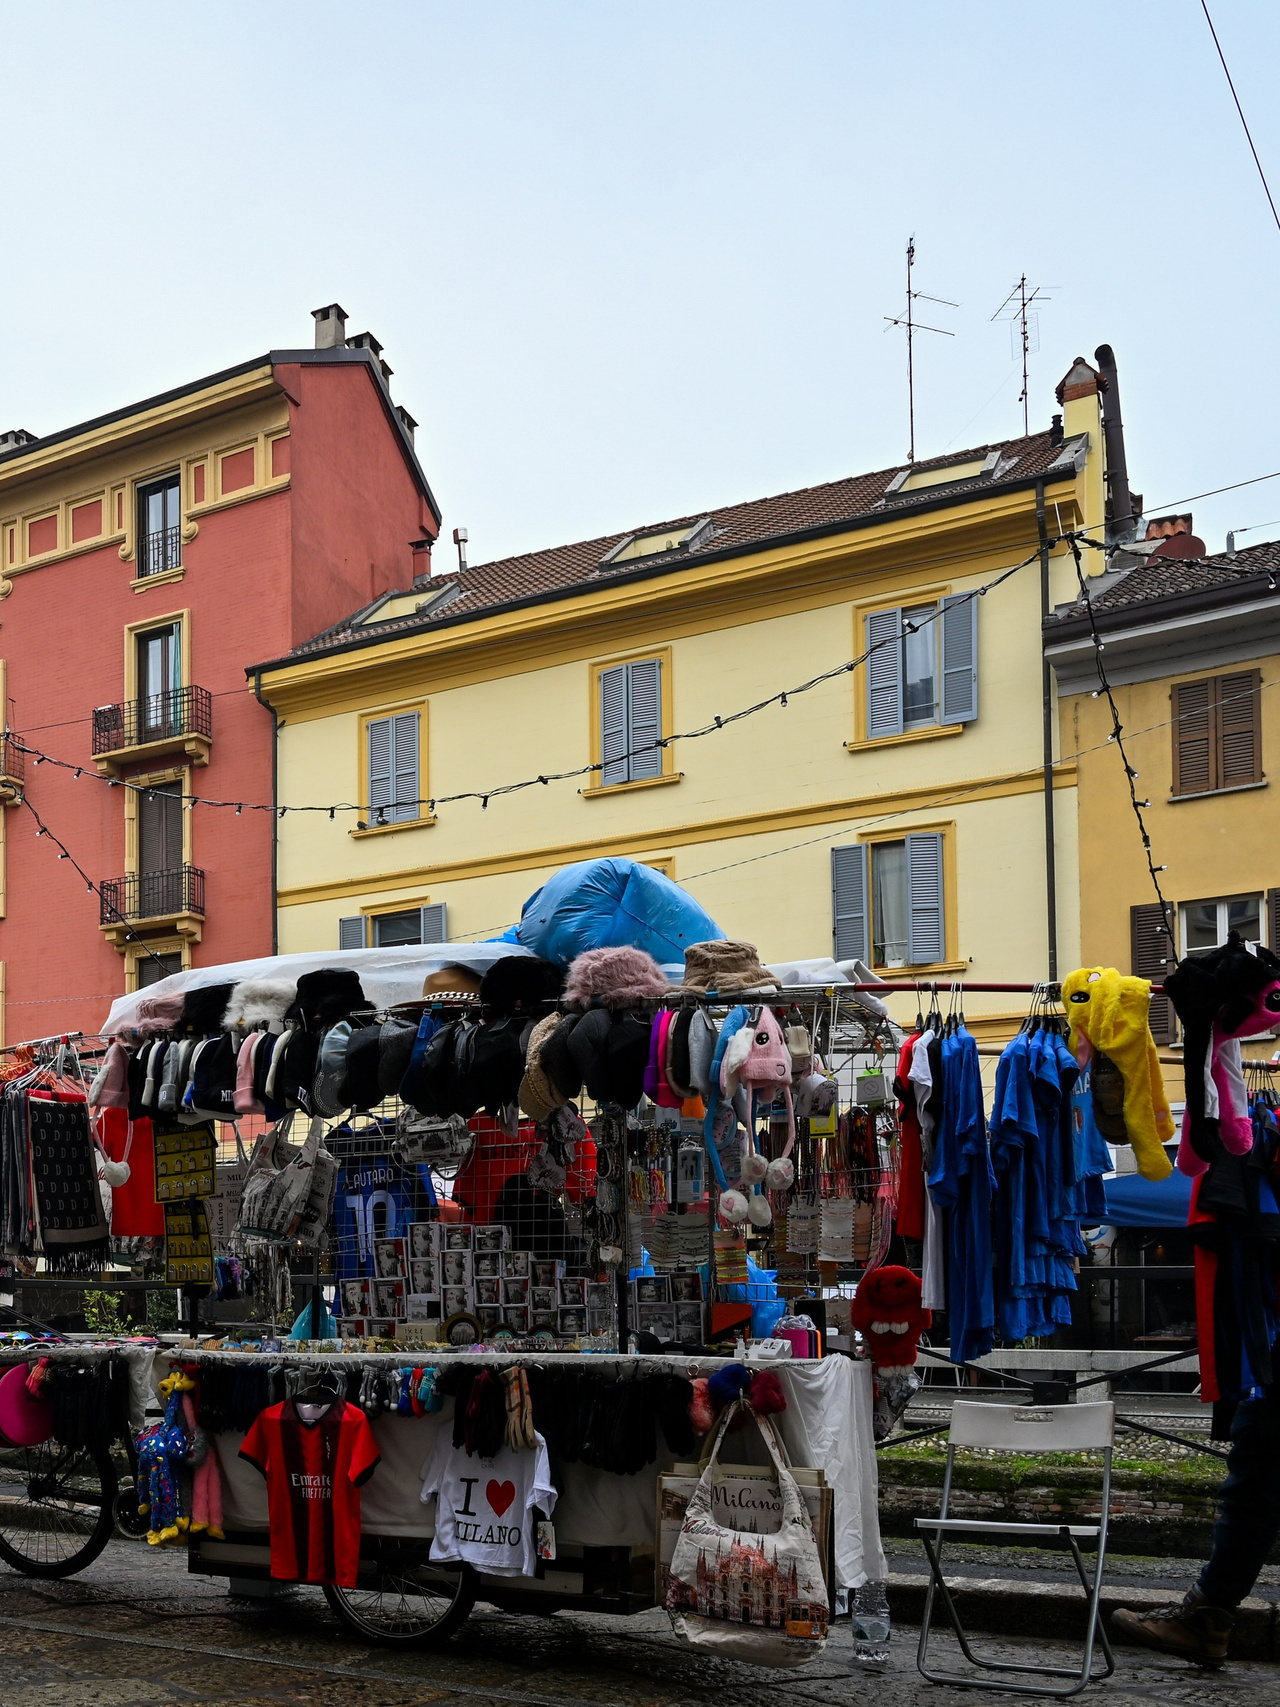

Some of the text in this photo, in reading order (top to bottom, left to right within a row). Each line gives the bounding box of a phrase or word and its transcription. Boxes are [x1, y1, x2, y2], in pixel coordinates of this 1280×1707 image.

[346, 1168, 394, 1189] LAUTARO
[346, 1190, 396, 1262] 10
[291, 1472, 331, 1487] Emirate
[455, 1478, 479, 1516] I
[713, 1486, 781, 1511] Milano
